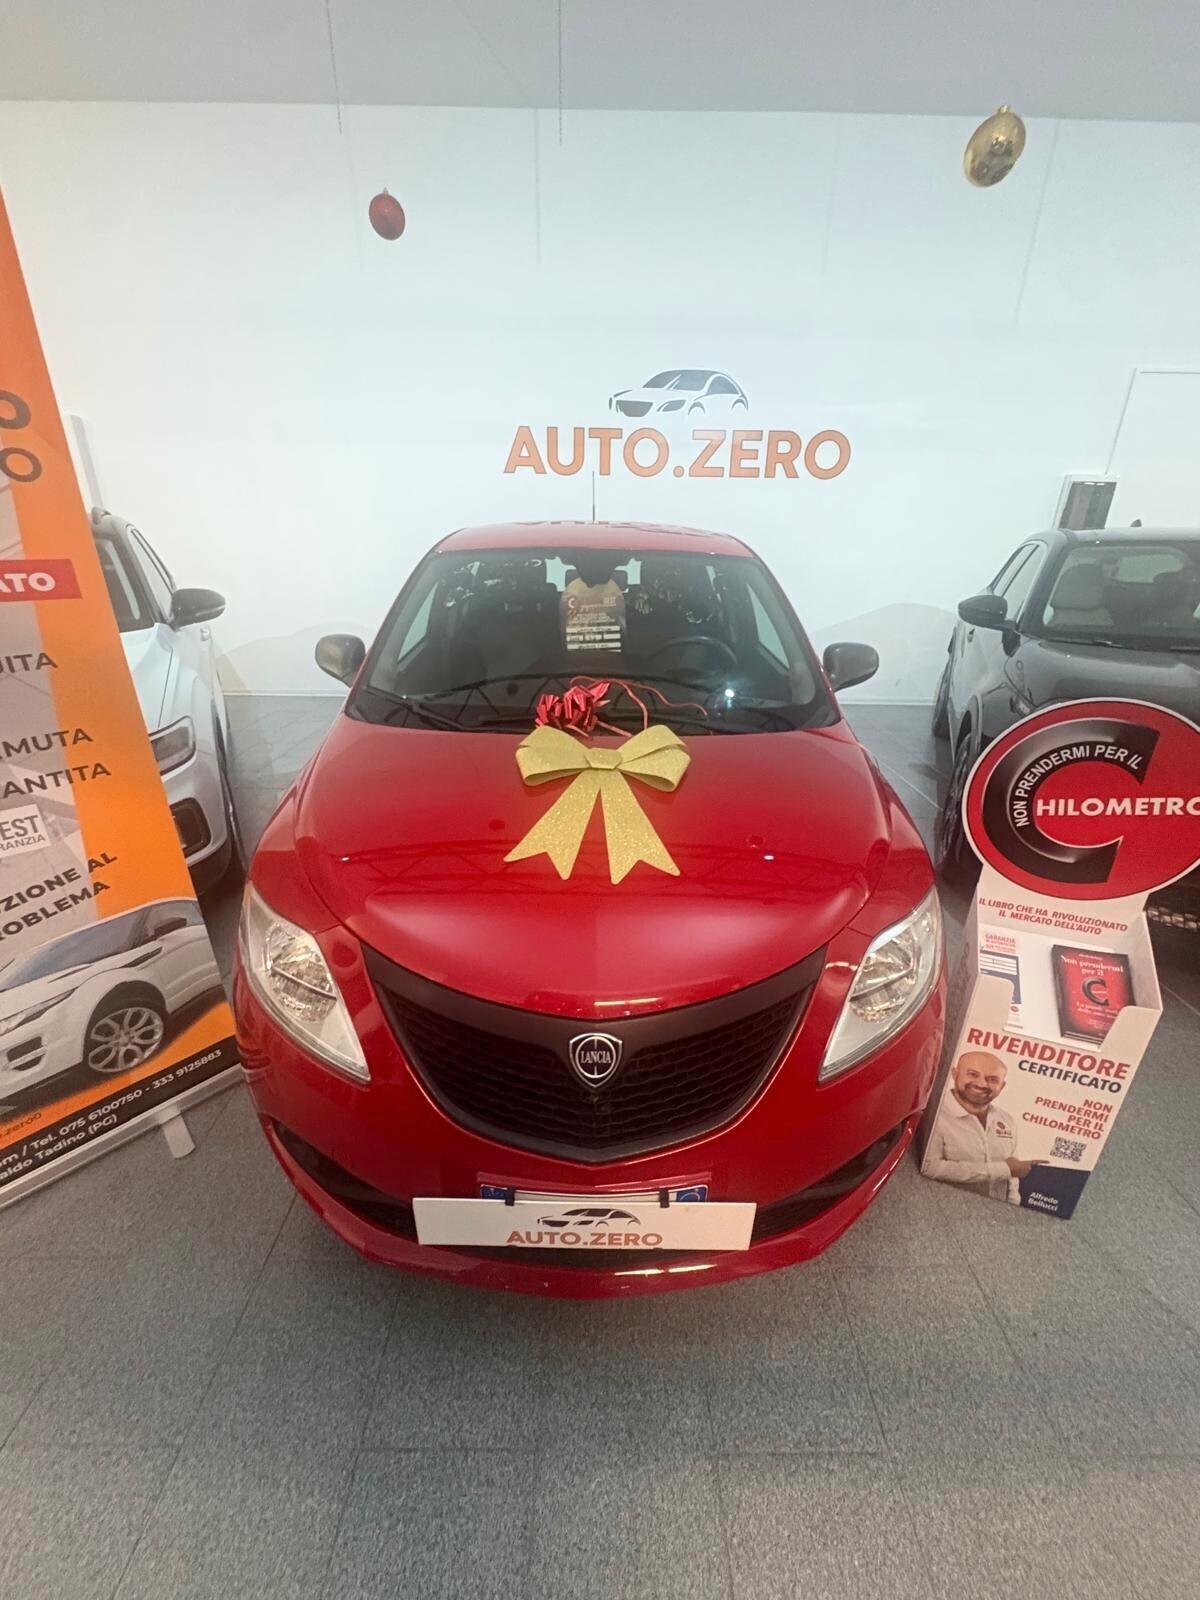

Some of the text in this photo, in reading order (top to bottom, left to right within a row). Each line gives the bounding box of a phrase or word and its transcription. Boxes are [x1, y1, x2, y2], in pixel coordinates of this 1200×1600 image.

[503, 425, 852, 480] AUTO.ZERO
[0, 652, 58, 674] ITA
[0, 728, 94, 760] MUTA
[2, 762, 112, 799] ANTITA
[1013, 744, 1143, 827] NON PRENDERMI PER IL
[87, 852, 118, 873] AL
[979, 898, 1128, 932] IL LIBRO CHE HA RIVOLUZIONATO
[999, 910, 1102, 935] IL MERCATO DELL'AUTO
[580, 1050, 612, 1064] LANCIA
[966, 1027, 1131, 1080] RIVENDITORE
[1018, 1059, 1122, 1093] CERTIFICATO
[30, 1133, 58, 1150] Tel.
[59, 1117, 87, 1136] 075
[88, 1089, 143, 1121] 6100750
[152, 1074, 175, 1089] 333
[1034, 1096, 1109, 1123] PRENDERMI
[1083, 1099, 1113, 1113] NON
[34, 1131, 86, 1159] Tadino
[87, 1113, 118, 1135] (PG)
[1022, 1112, 1101, 1140] CHILOMETRO
[1067, 1114, 1105, 1132] PER IL
[1030, 1191, 1058, 1204] Alfredo
[506, 1230, 664, 1247] AUTO.ZERO
